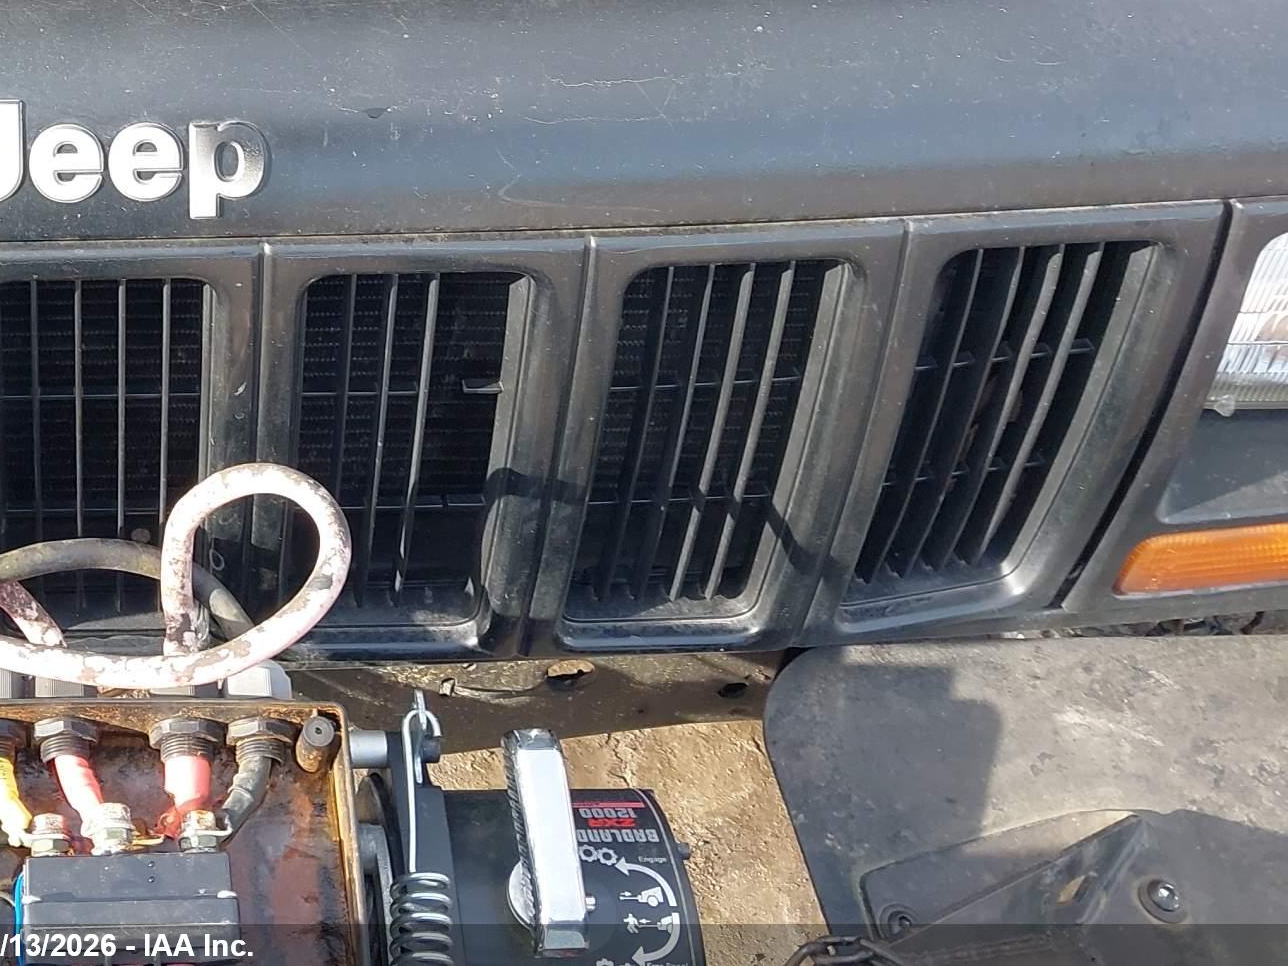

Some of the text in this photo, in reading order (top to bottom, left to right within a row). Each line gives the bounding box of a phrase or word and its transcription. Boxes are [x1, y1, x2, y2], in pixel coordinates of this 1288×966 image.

[579, 808, 637, 818] 12000
[577, 829, 660, 842] BADLAND
[638, 856, 667, 864] Engage
